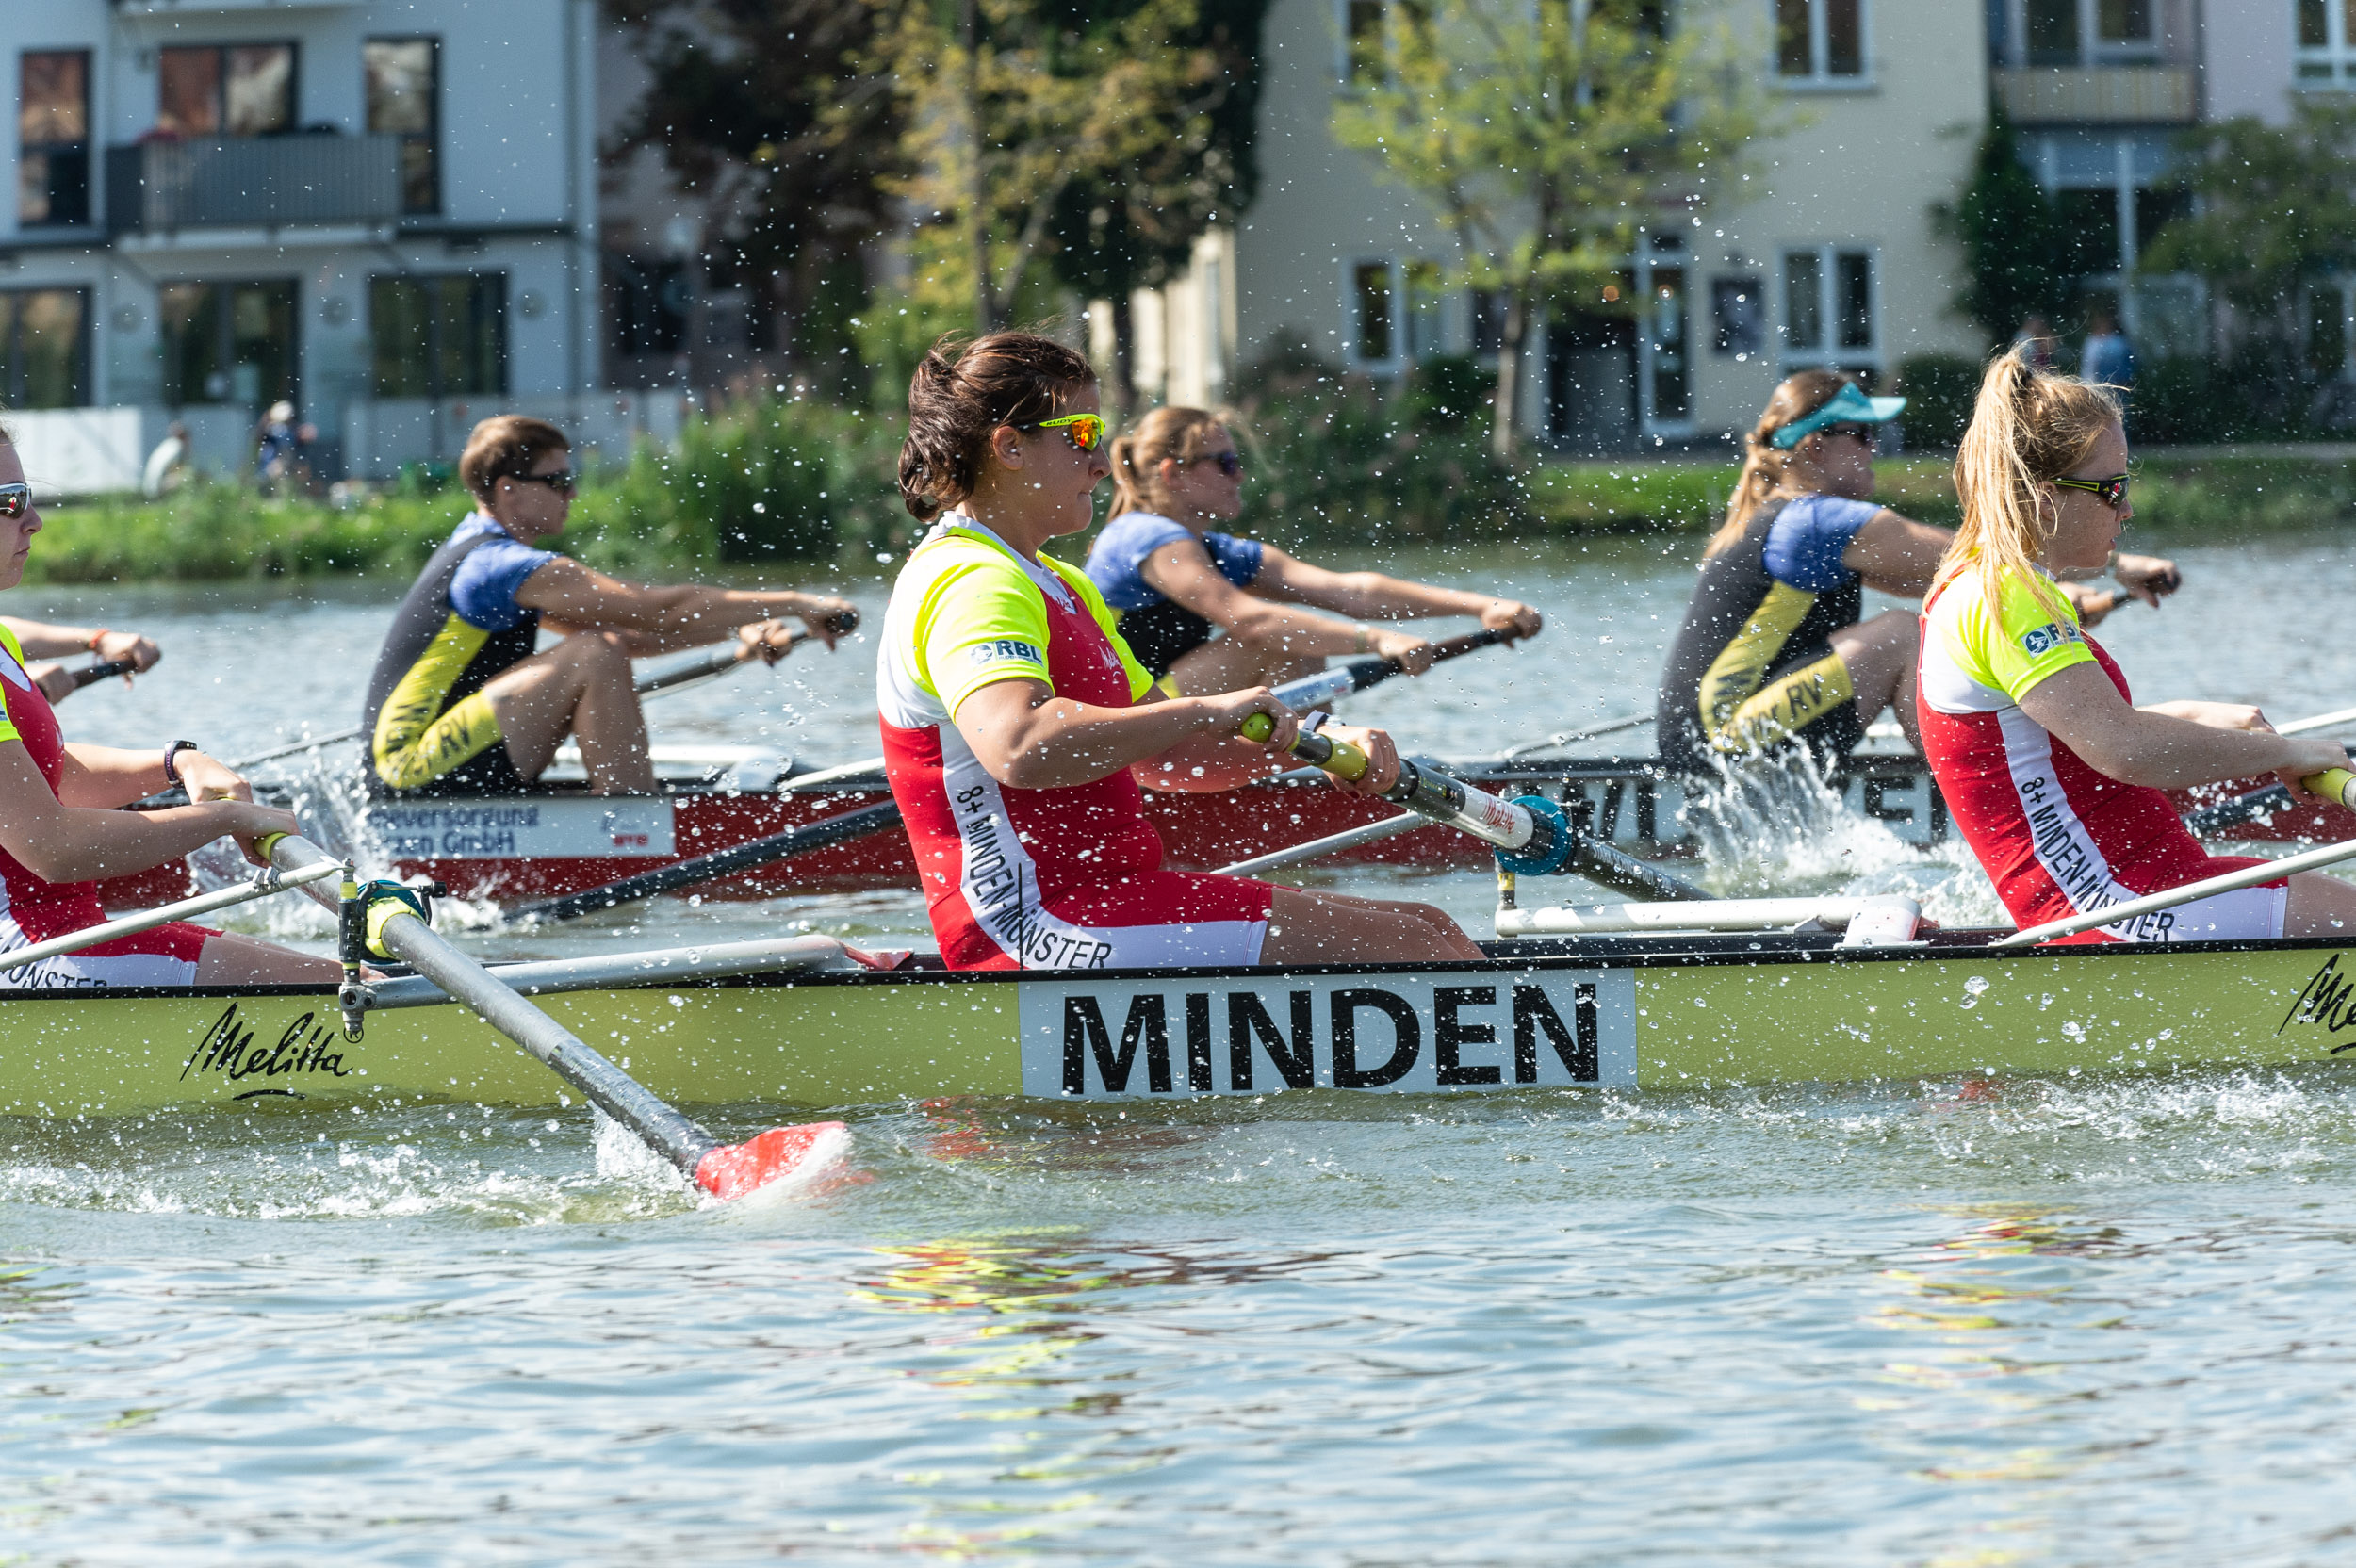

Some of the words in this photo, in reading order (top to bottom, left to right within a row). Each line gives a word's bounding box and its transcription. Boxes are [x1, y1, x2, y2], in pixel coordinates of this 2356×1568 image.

[995, 640, 1042, 663] RBL
[957, 785, 984, 814] 8+
[2021, 776, 2047, 804] 8+
[442, 831, 515, 853] GmbH
[180, 1001, 353, 1083] Melitta
[1062, 983, 1600, 1095] MINDEN
